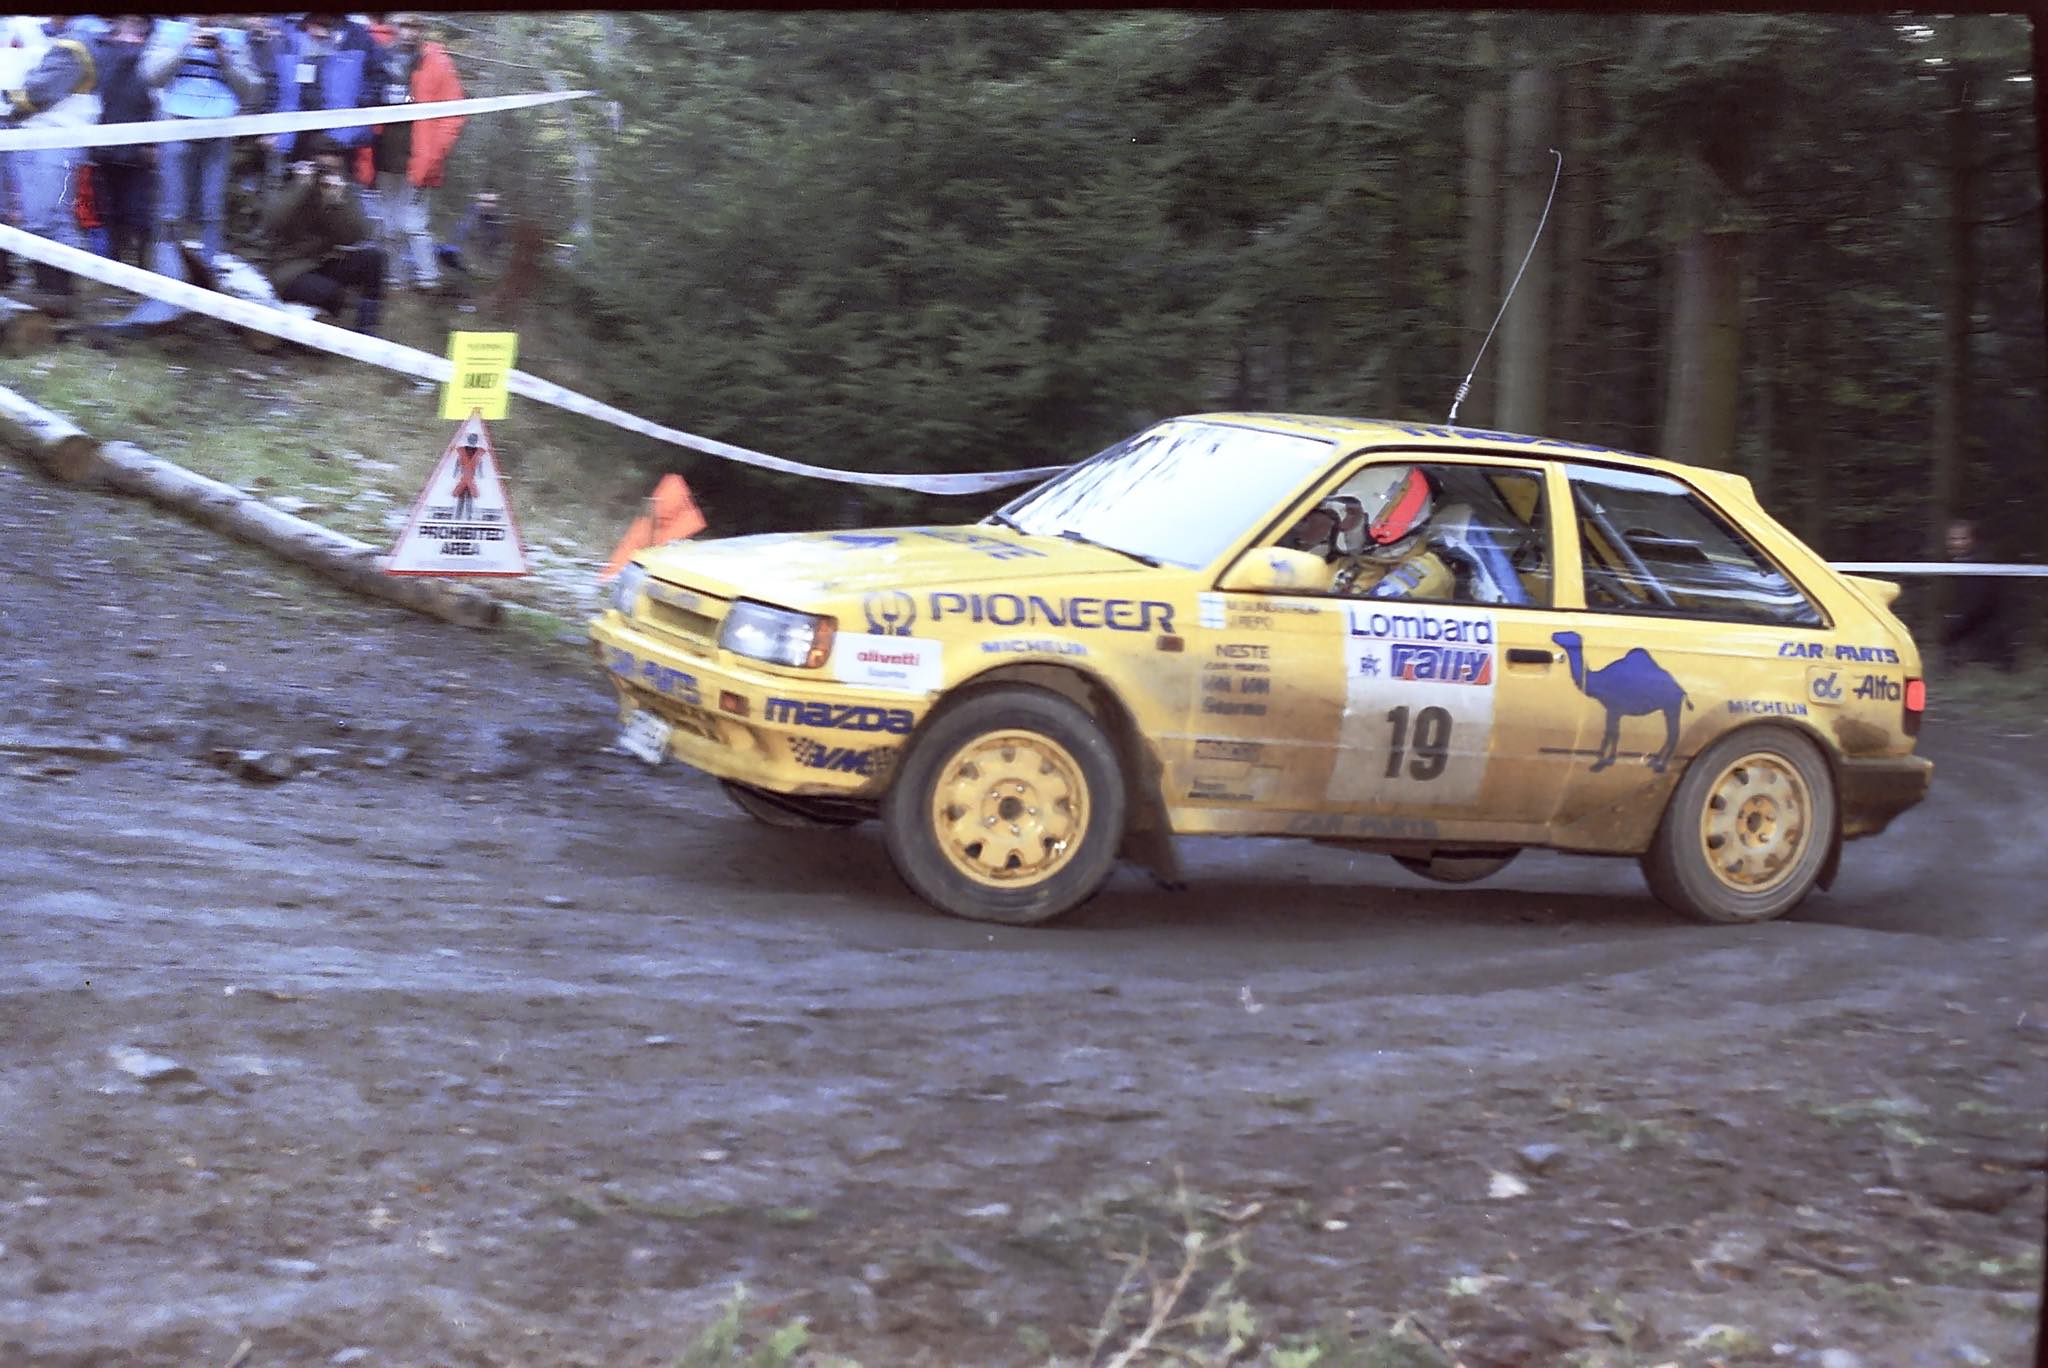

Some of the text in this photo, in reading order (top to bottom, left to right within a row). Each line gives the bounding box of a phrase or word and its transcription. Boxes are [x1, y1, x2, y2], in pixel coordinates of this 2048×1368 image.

[419, 525, 505, 541] PROHIBITED
[441, 542, 479, 555] AREA
[931, 592, 1176, 633] PIONEER
[1350, 611, 1493, 645] Lombard
[1216, 644, 1270, 659] NESTE
[1778, 642, 1899, 664] CAR PARTS
[1392, 645, 1490, 683] rally
[1853, 675, 1900, 701] Alfa
[1728, 700, 1808, 715] MICHELIN
[1385, 706, 1453, 781] 19
